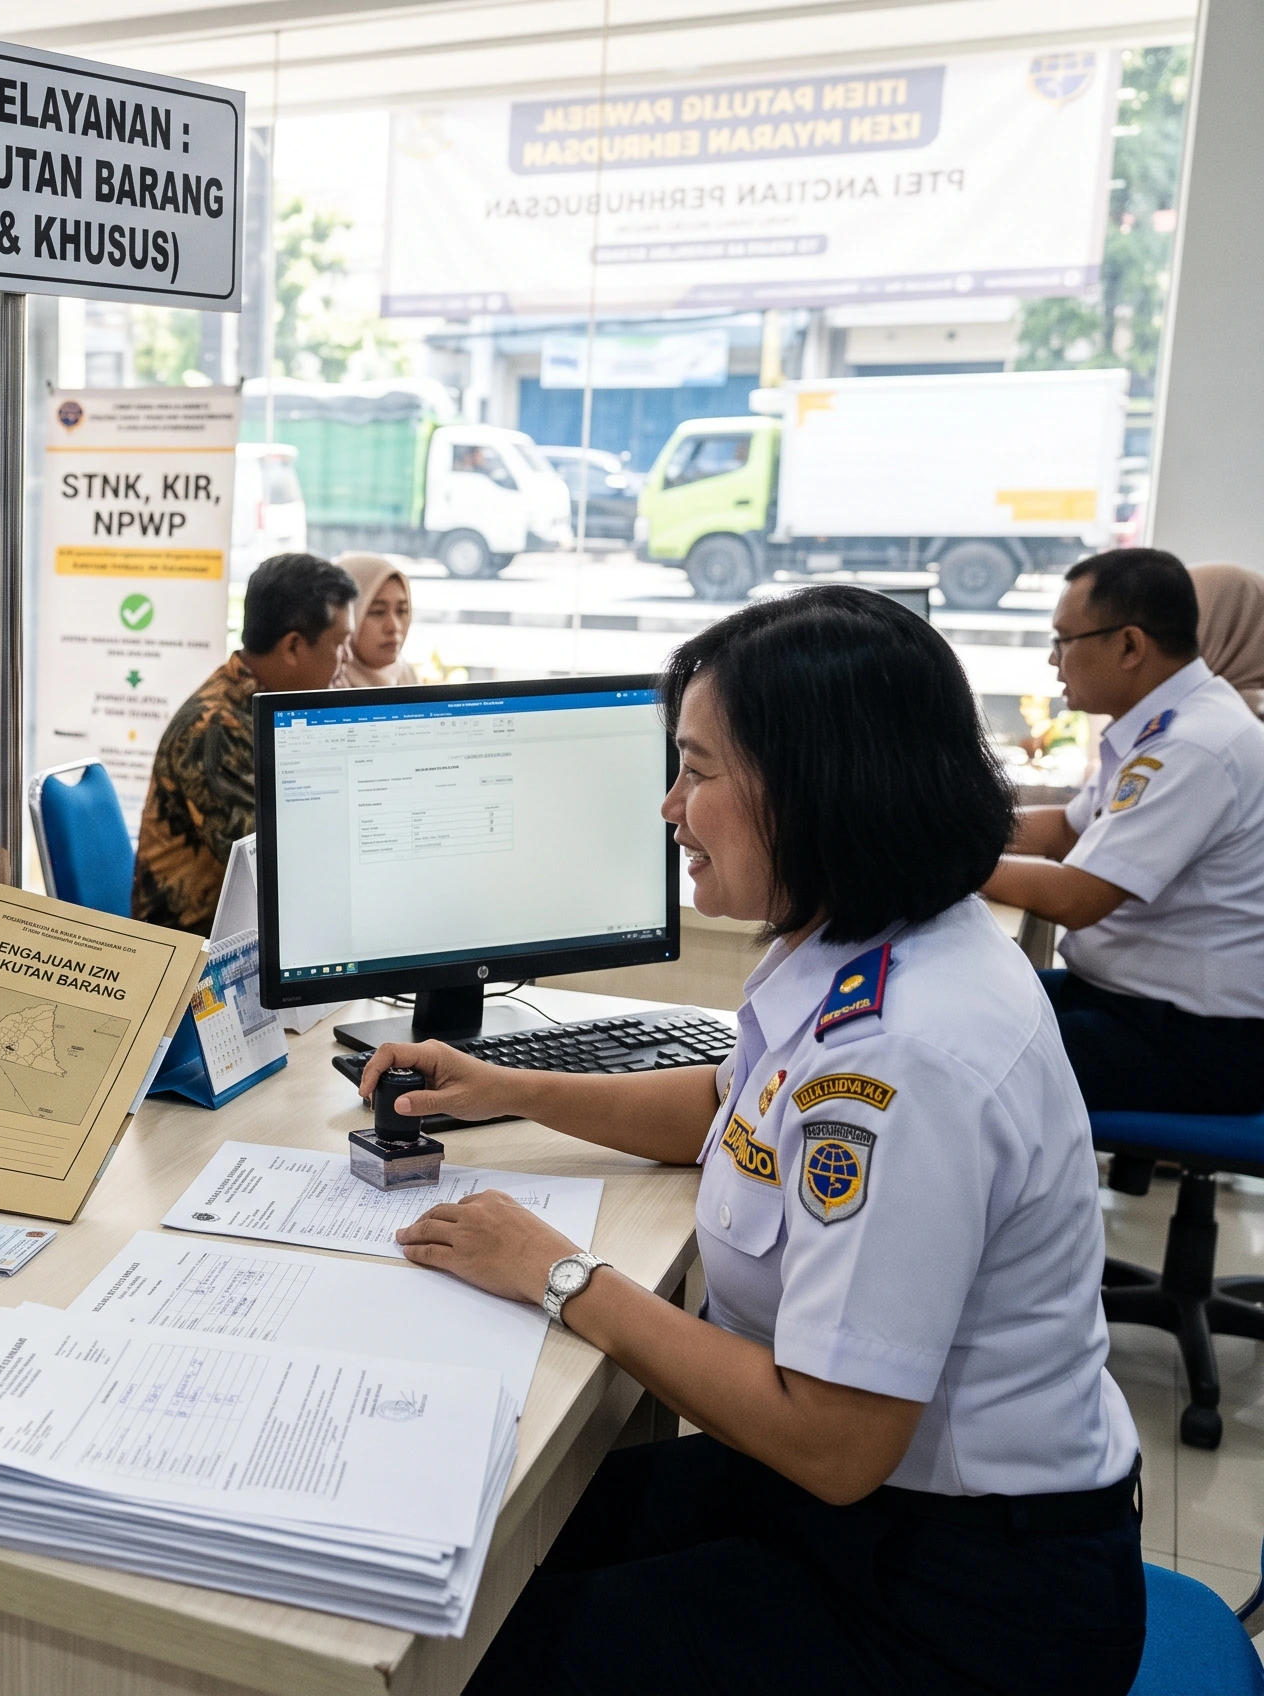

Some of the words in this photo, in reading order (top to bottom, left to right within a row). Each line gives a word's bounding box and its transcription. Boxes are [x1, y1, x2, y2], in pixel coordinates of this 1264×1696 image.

[95, 160, 224, 219] BARANG
[34, 215, 180, 285] KHUSUS)
[62, 473, 150, 505] STNK,
[162, 474, 221, 506] KIR,
[93, 511, 187, 537] NPWP
[56, 974, 127, 1001] BARANG
[88, 964, 121, 983] IZIN
